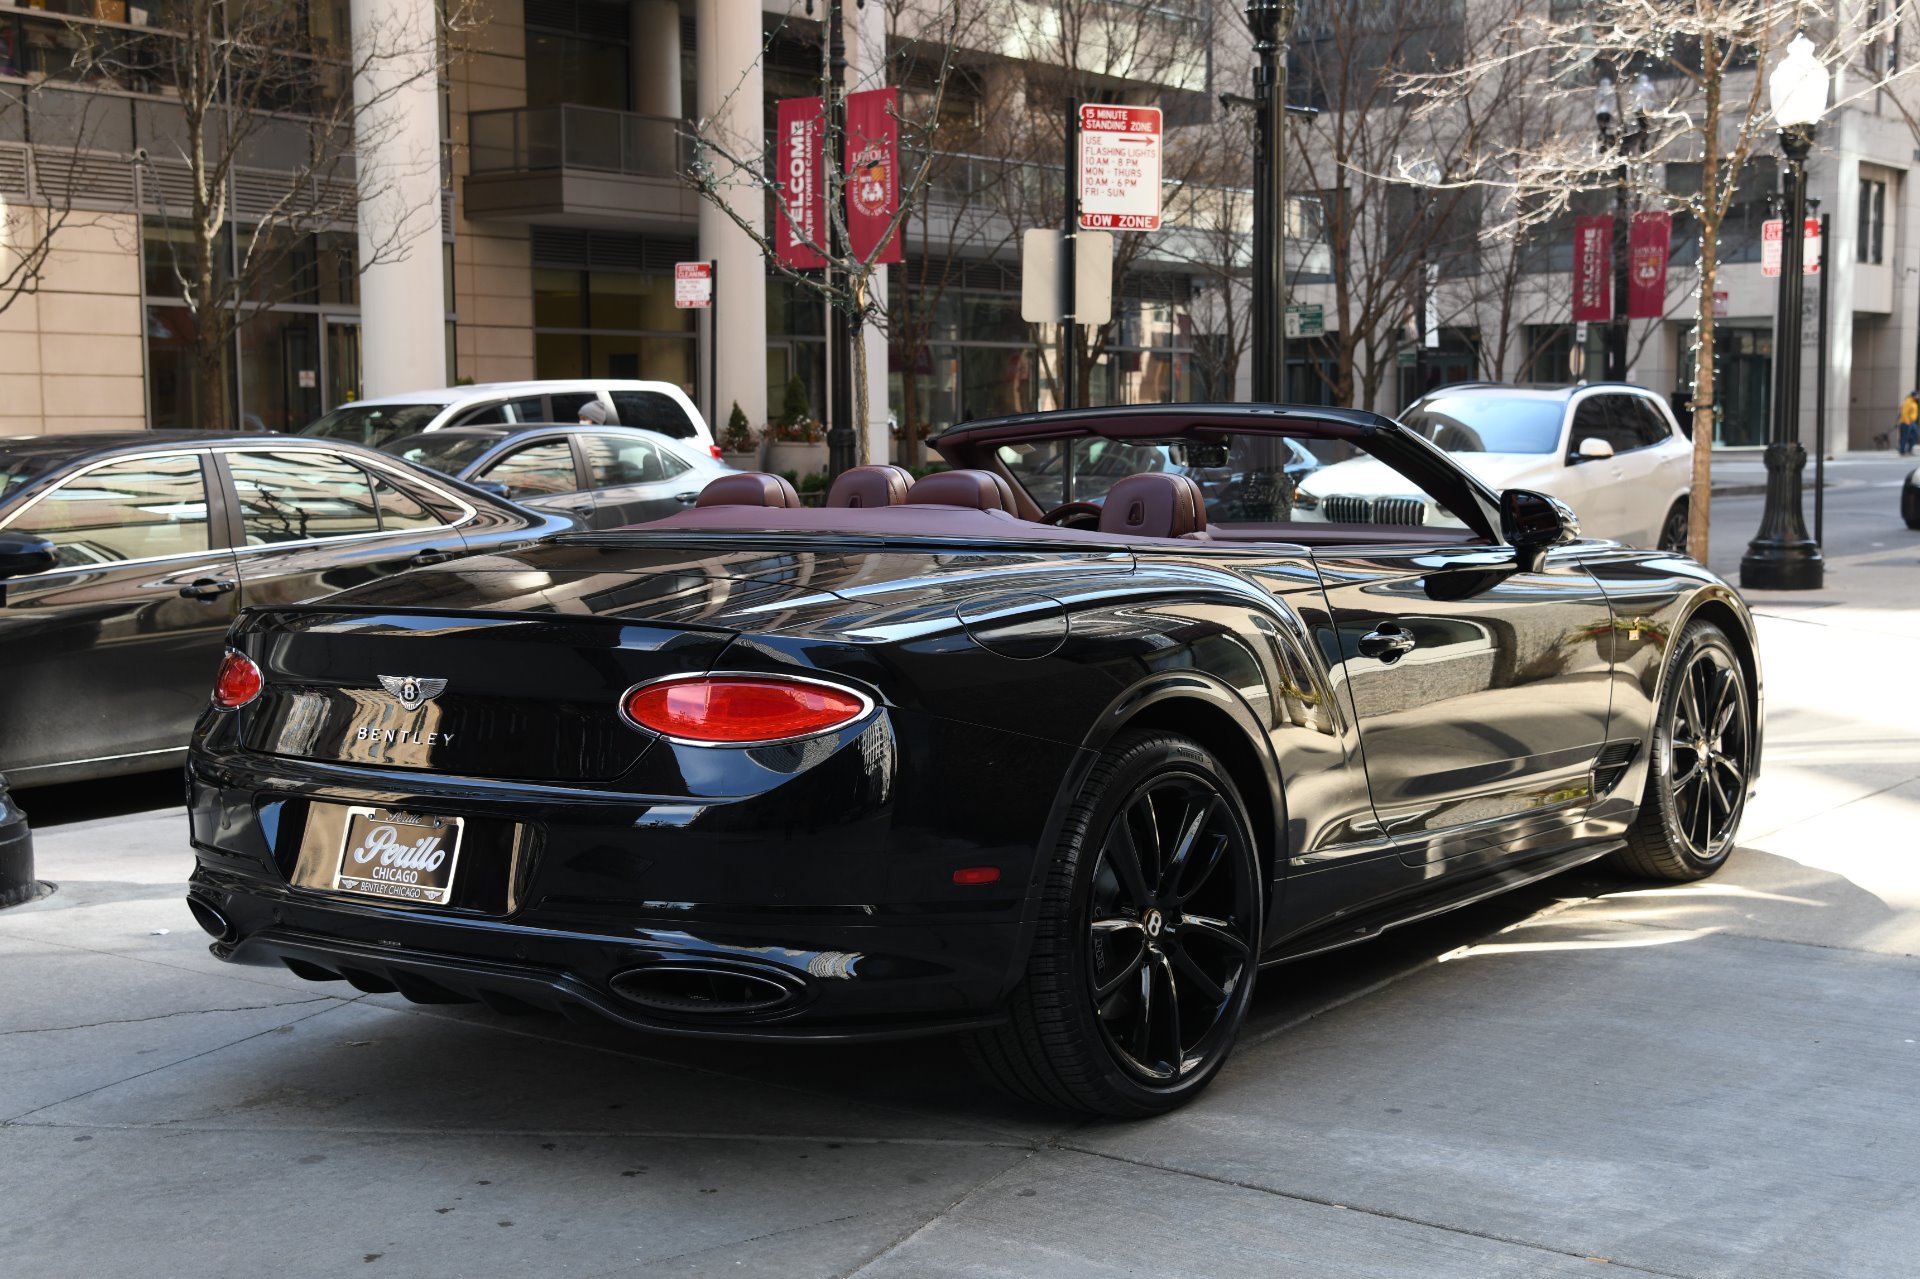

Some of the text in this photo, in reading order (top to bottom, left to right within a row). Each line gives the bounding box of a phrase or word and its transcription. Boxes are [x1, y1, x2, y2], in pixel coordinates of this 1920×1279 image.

[1086, 109, 1128, 120] 15 MINUTE
[1086, 120, 1152, 132] STANDING ZONE
[1085, 136, 1102, 145] USE
[1085, 147, 1156, 158] FLASHING LIGHTS
[1126, 159, 1138, 167] PM
[1085, 168, 1104, 176] MON
[1114, 168, 1142, 177] THURS
[806, 169, 814, 206] TOWER
[1117, 179, 1122, 187] 6
[1125, 179, 1137, 187] PM
[1085, 188, 1099, 196] FRI
[1107, 189, 1125, 197] SUN
[1085, 214, 1152, 228] TOW ZONE
[358, 727, 455, 746] BENTLEY
[385, 811, 423, 824] Perillo
[354, 825, 446, 872] Perillo
[372, 866, 418, 883] CHICAGO
[360, 881, 389, 894] BENTLEY
[389, 885, 421, 898] CHICAGO
